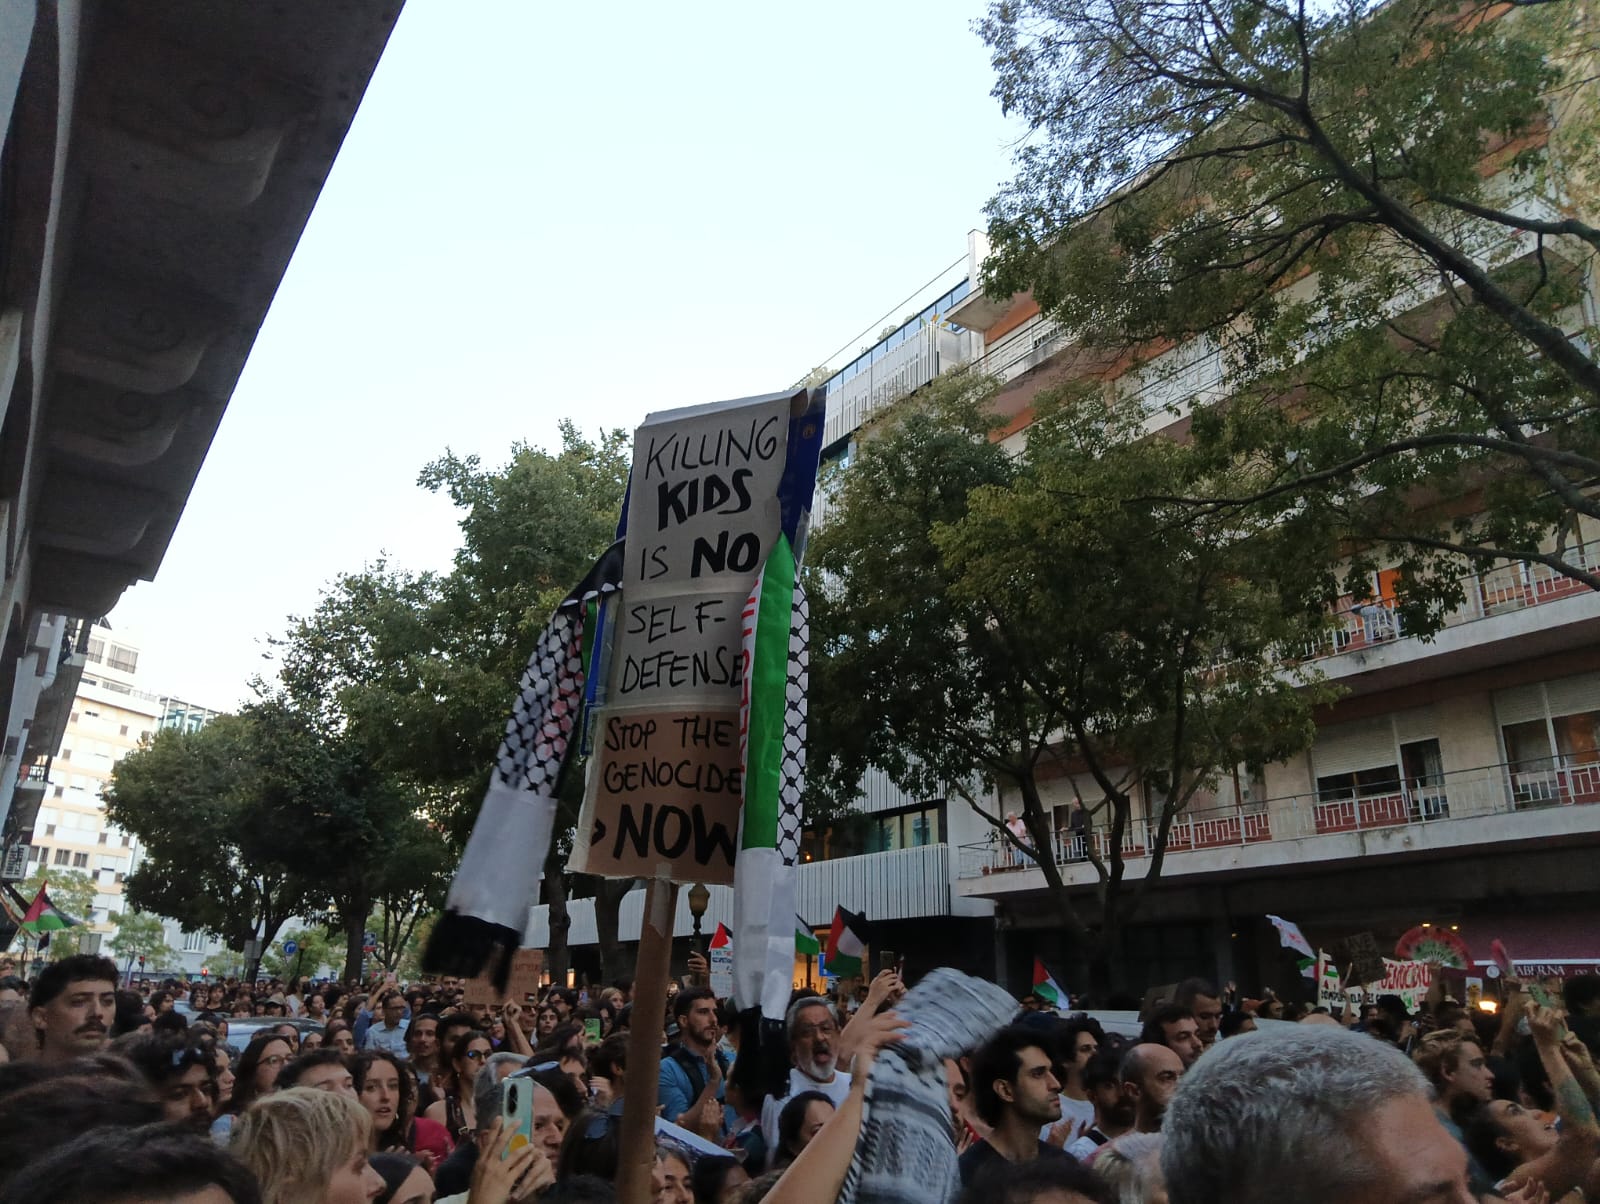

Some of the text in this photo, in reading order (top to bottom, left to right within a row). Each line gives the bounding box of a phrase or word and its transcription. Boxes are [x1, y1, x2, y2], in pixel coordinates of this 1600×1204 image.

[645, 416, 778, 480] KILLING
[658, 469, 753, 531] KIDS
[640, 531, 760, 580] IS NO
[628, 600, 726, 644] SELF-
[620, 646, 742, 694] DEFENSE
[605, 715, 733, 751] STOP THE
[605, 758, 742, 794] GENOCIDE
[613, 803, 736, 866] NOW
